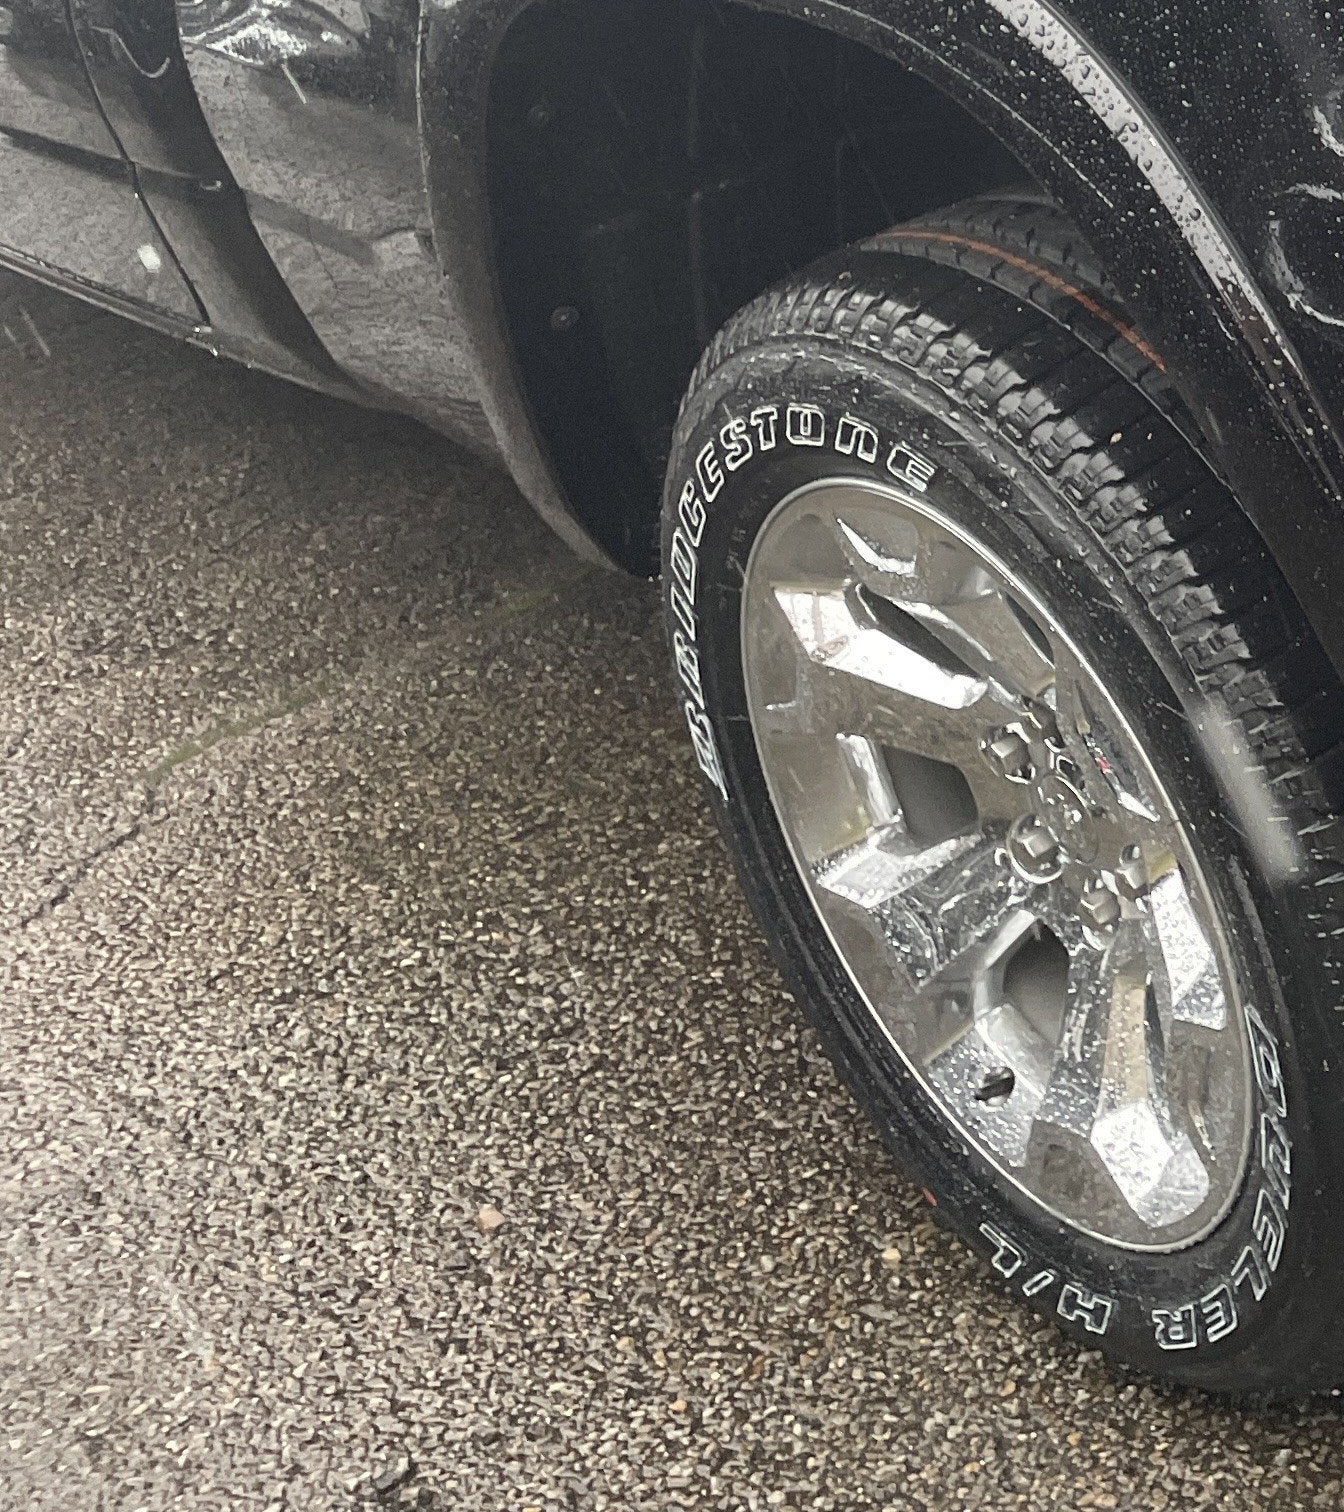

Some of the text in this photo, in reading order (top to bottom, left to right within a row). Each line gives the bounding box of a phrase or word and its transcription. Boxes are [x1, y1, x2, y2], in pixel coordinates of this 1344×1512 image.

[669, 403, 938, 801] BRIDGESTONE
[979, 1003, 1292, 1350] DUELER H/L
